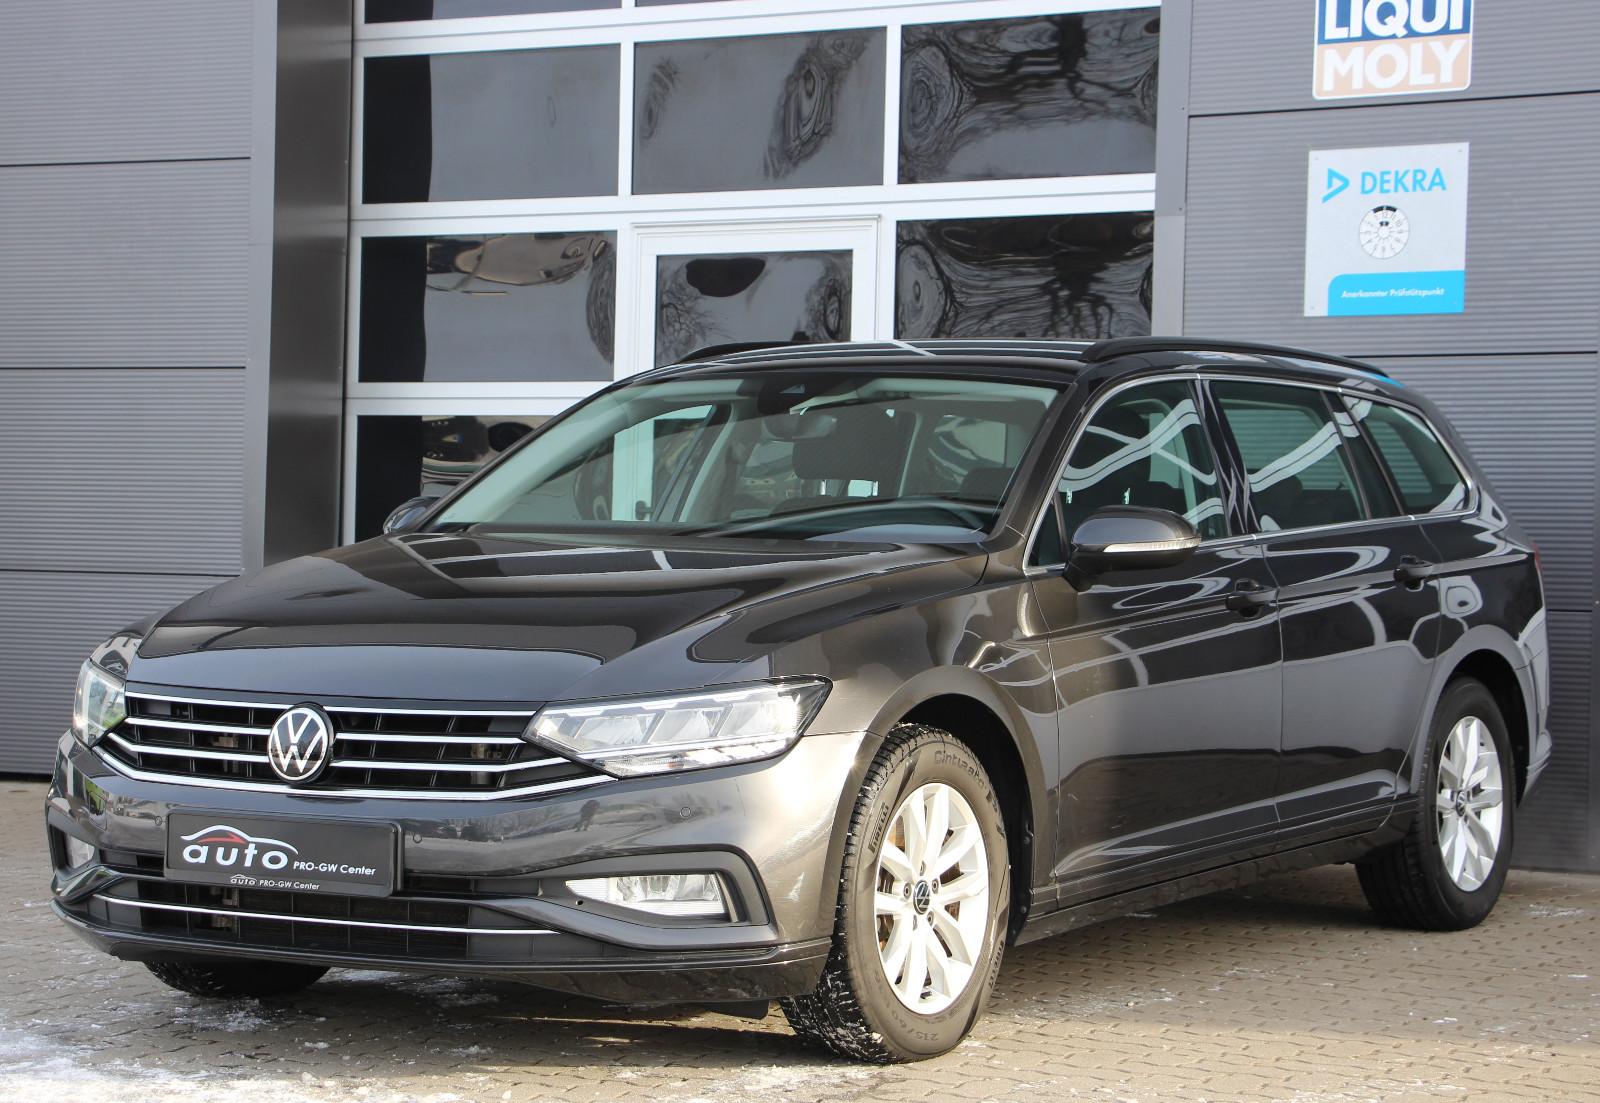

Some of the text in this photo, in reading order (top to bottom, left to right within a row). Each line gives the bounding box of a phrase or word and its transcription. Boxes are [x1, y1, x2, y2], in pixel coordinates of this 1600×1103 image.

[1324, 0, 1465, 40] LIQUI
[1322, 40, 1467, 92] MOLY
[1360, 168, 1447, 195] DEKRA
[182, 843, 288, 870] auto
[293, 861, 376, 876] PRO-GW Center
[231, 877, 320, 891] auto PRO-GW Center
